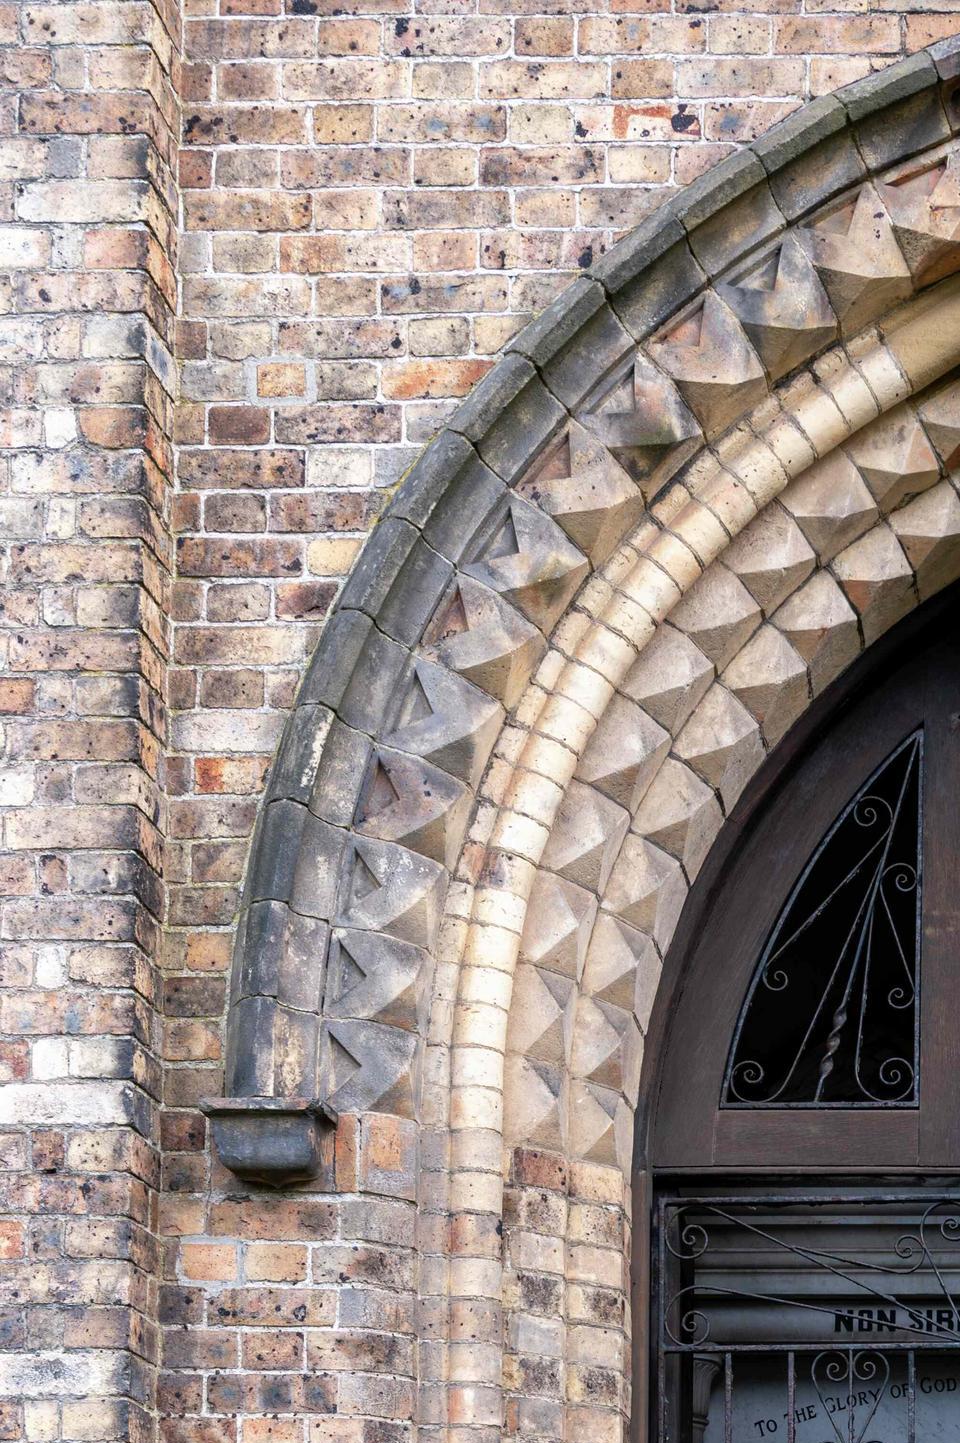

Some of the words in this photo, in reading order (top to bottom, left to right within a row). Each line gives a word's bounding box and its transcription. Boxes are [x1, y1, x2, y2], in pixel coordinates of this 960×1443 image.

[834, 1309, 896, 1333] NON
[755, 1418, 777, 1437] TO
[825, 1387, 881, 1414] GLORY
[890, 1384, 910, 1399] OF
[920, 1377, 957, 1394] GOD
